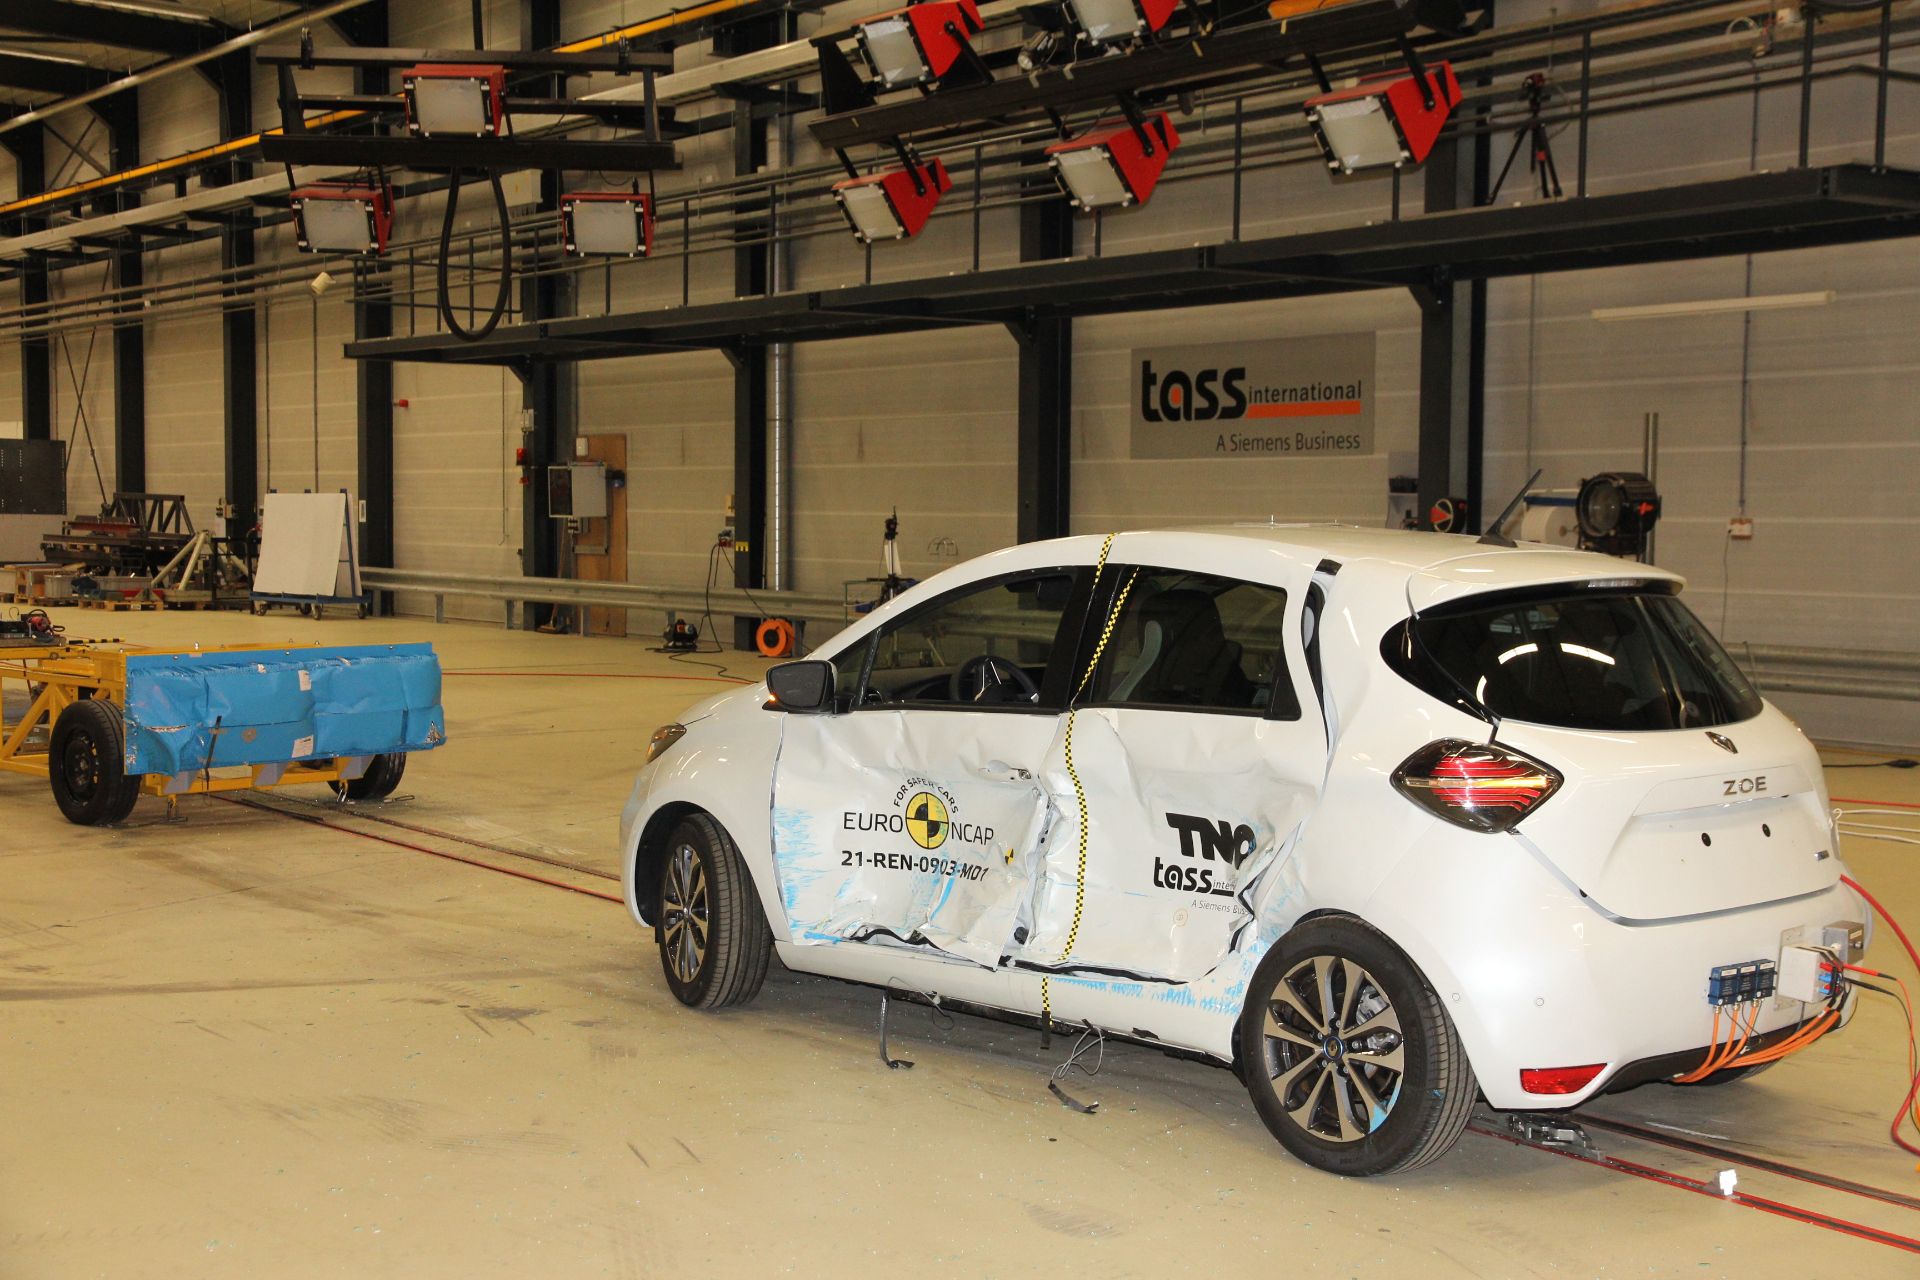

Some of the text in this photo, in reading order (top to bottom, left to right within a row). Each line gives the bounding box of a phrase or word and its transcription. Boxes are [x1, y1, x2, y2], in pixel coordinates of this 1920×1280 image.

[1141, 360, 1362, 422] tass international
[1216, 431, 1361, 451] A Siemens Business
[893, 784, 909, 807] FOR
[937, 786, 959, 814] CARS
[1722, 776, 1767, 796] ZOE
[843, 811, 994, 846] EURO NCAP
[1153, 856, 1213, 894] tass
[1191, 899, 1198, 908] A
[1198, 899, 1231, 913] Siemens
